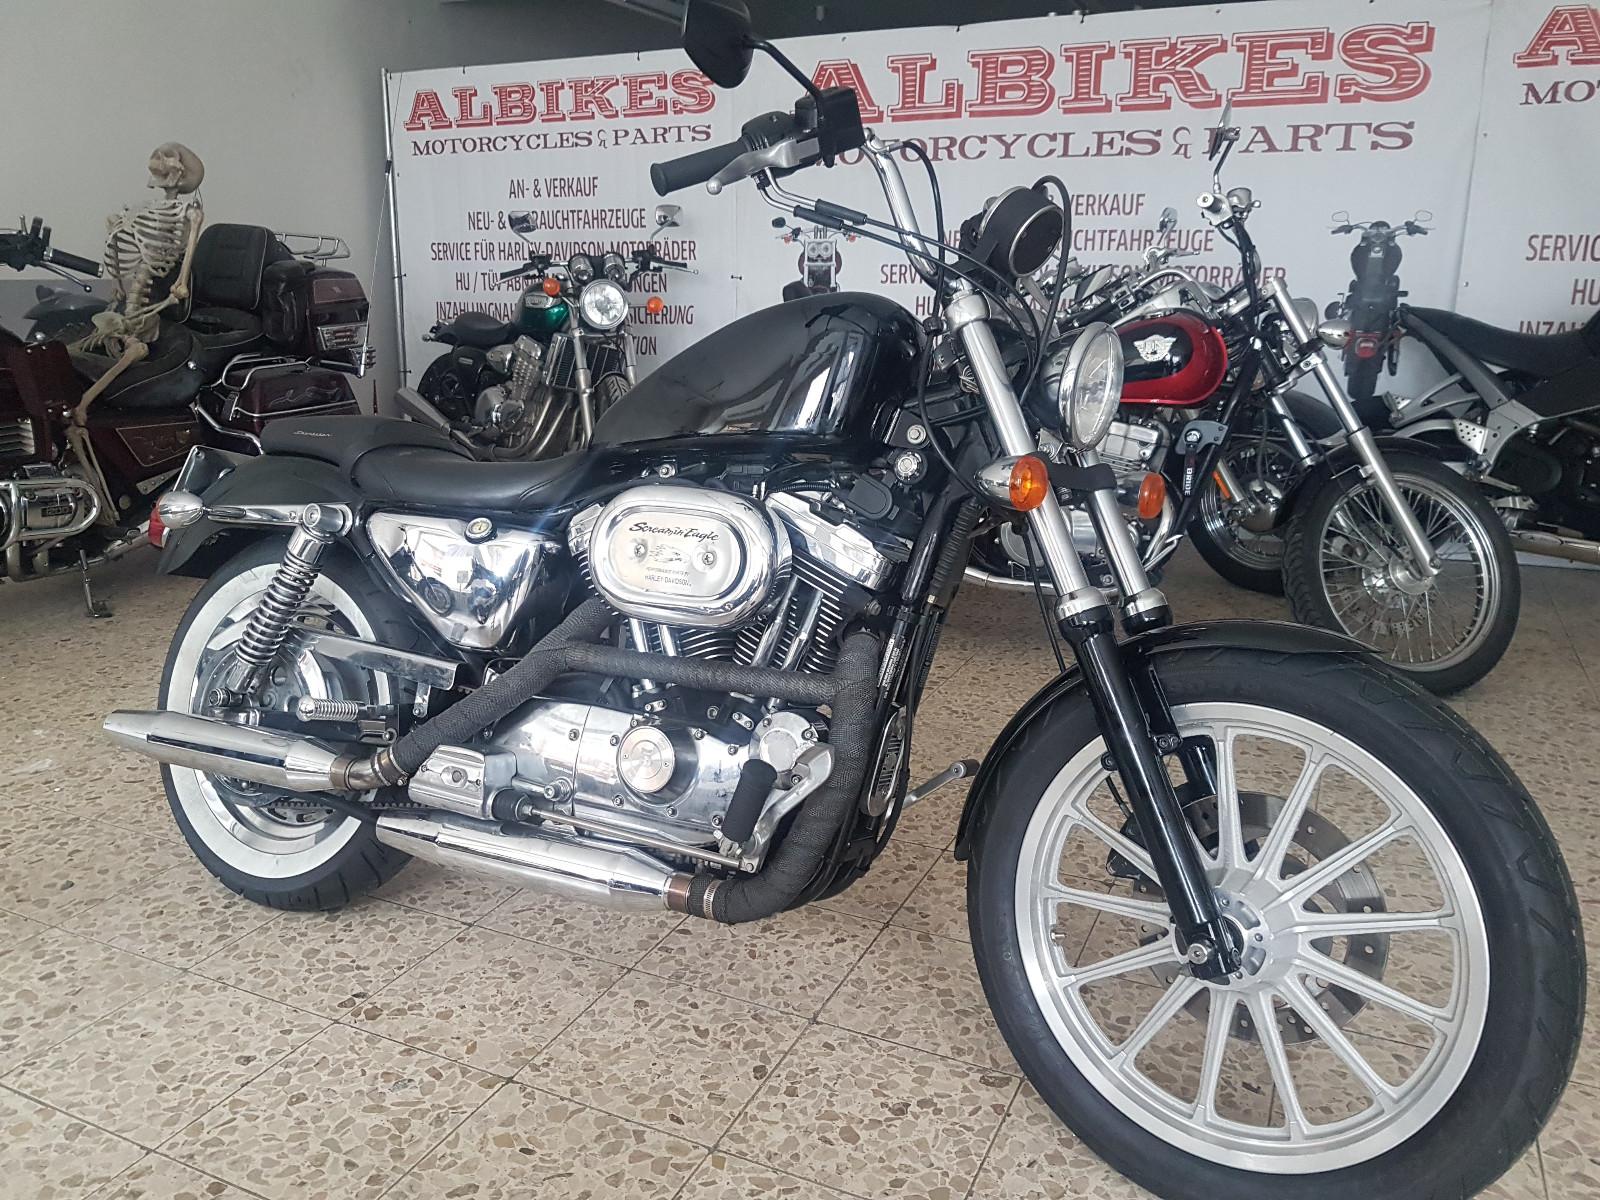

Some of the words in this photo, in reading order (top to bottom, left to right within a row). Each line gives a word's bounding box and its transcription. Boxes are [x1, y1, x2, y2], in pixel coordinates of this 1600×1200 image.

[803, 20, 1436, 125] ALBIKES
[403, 69, 717, 131] ALBIKES
[411, 131, 593, 156] MOTORCYCLES
[612, 124, 712, 146] PARTS
[816, 128, 1162, 166] ORCYCLES
[509, 178, 530, 199] AN-
[533, 178, 542, 198] &
[544, 176, 599, 198] VERKAUF
[468, 210, 494, 231] NEU-
[497, 210, 507, 230] &
[430, 242, 471, 261] SERVICE
[474, 238, 495, 261] FÜR
[1525, 234, 1600, 262] SERVIC
[455, 272, 470, 291] HU
[684, 527, 719, 543] Eagle
